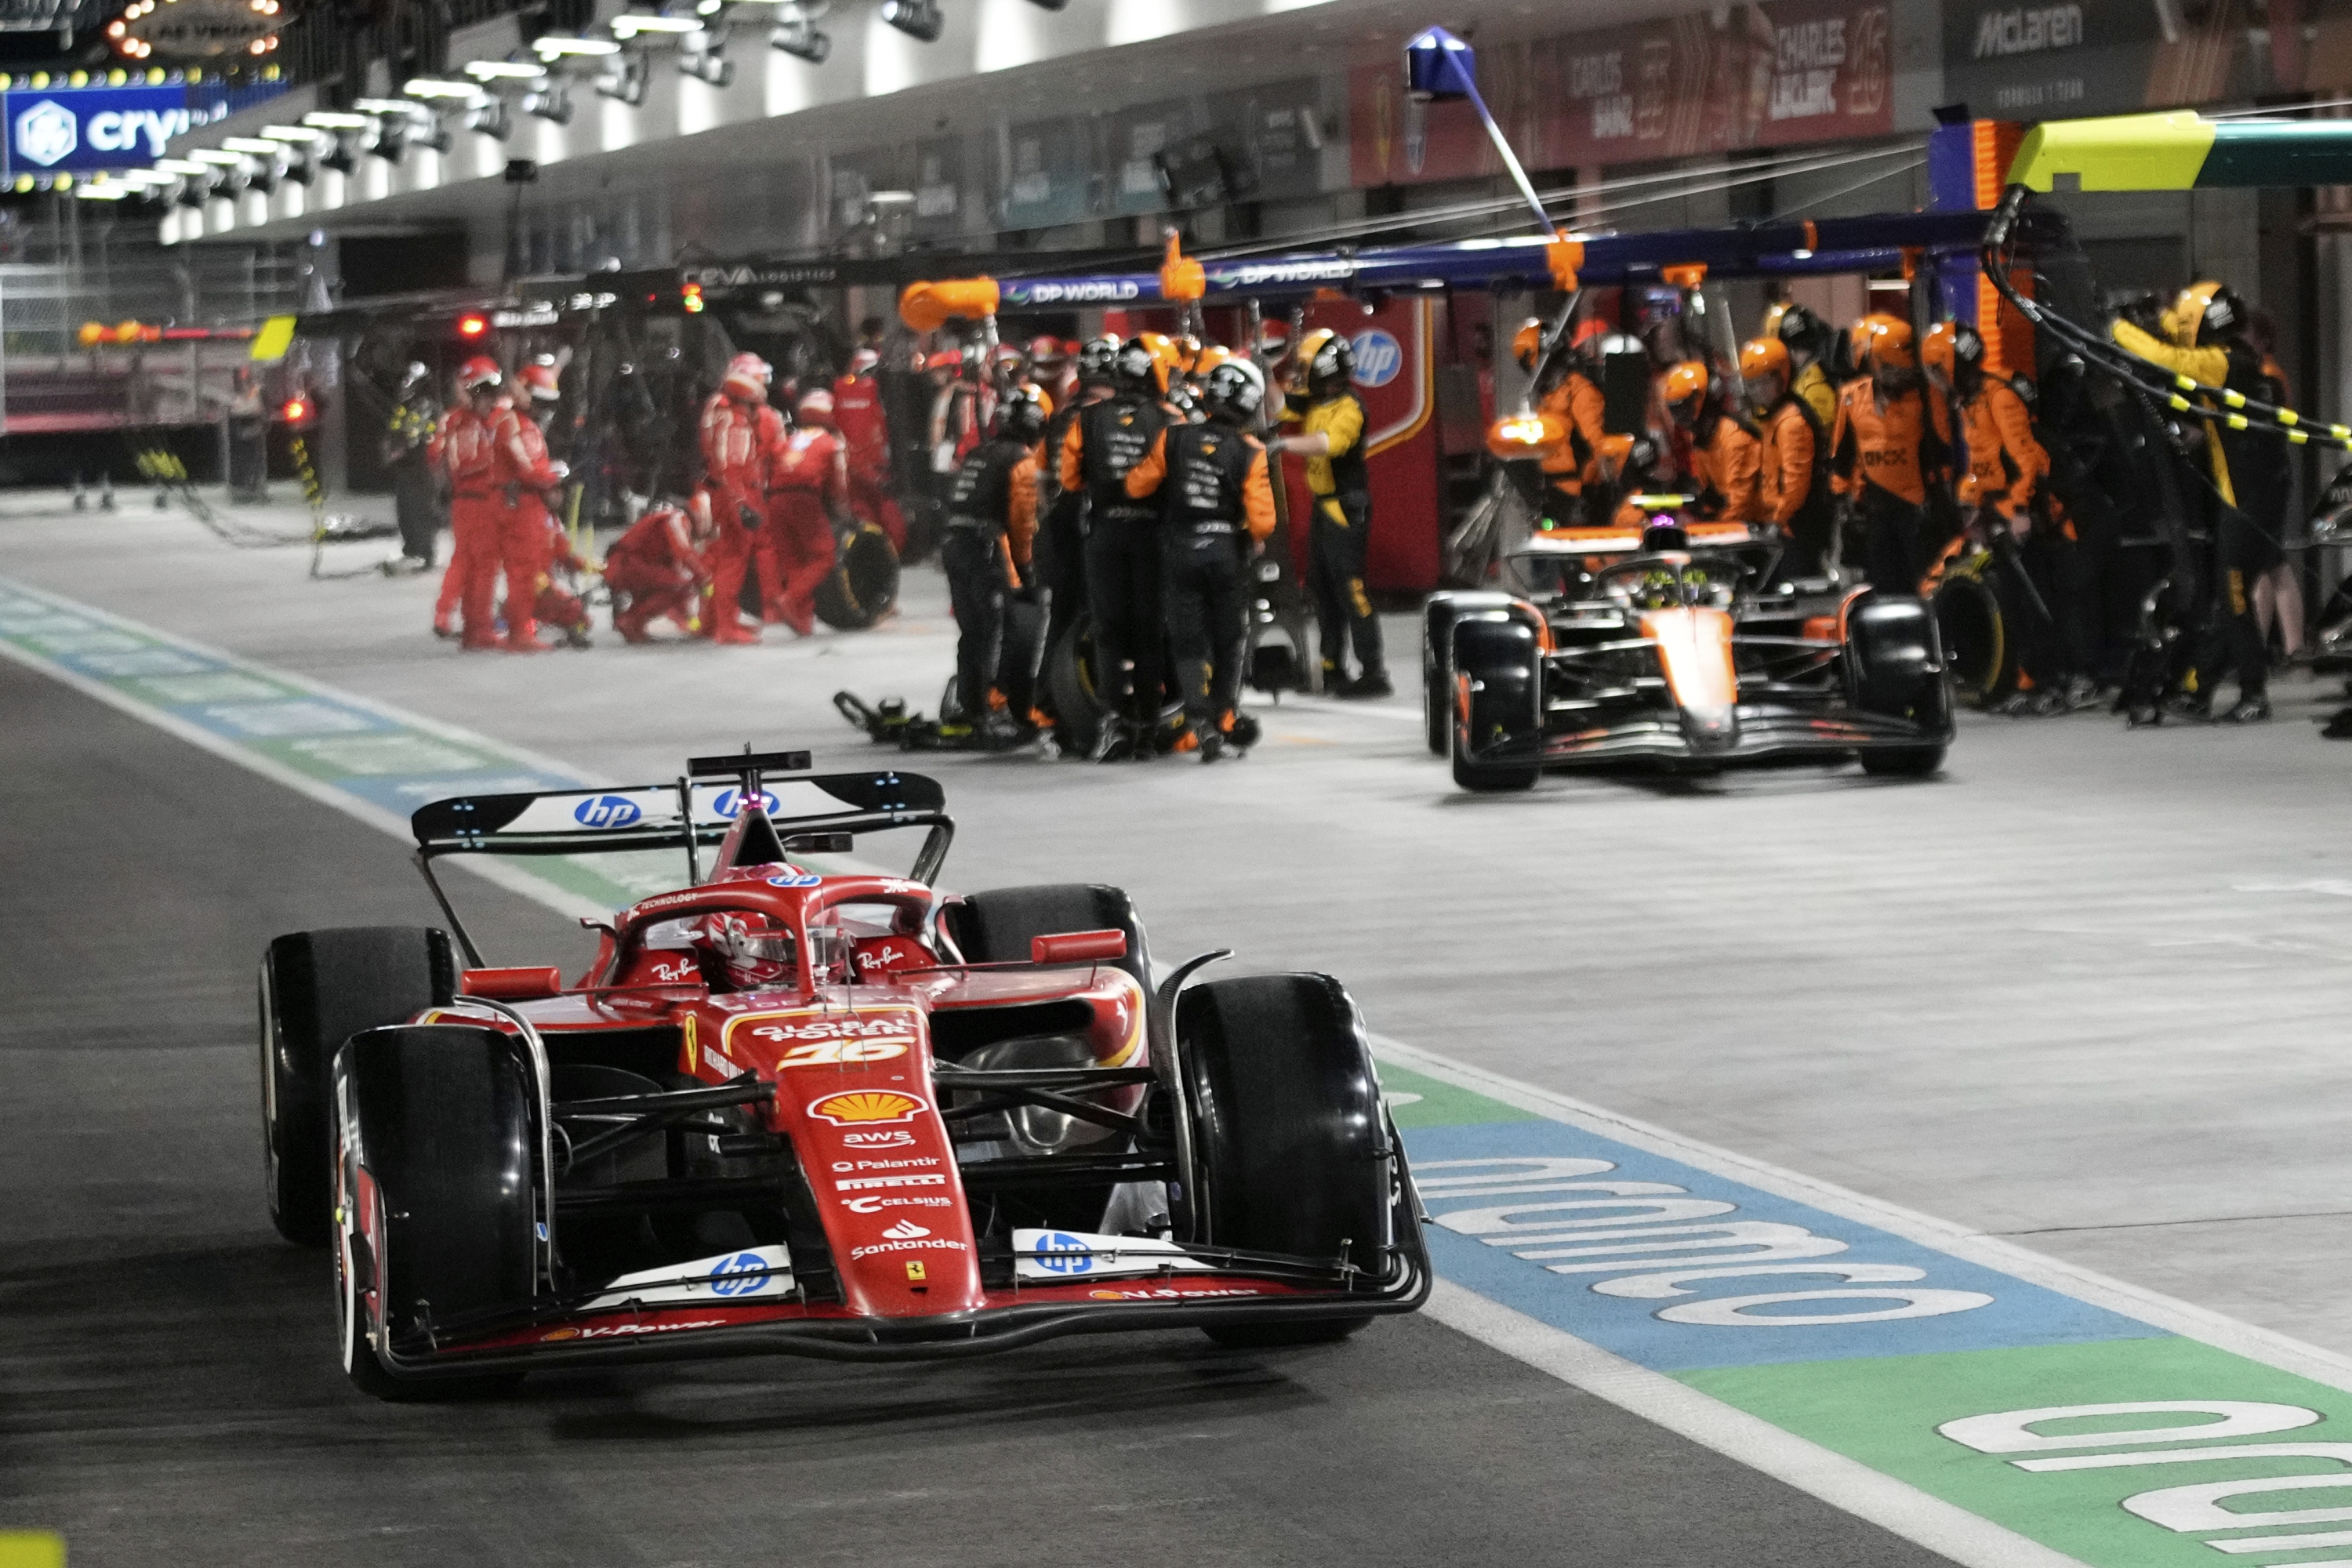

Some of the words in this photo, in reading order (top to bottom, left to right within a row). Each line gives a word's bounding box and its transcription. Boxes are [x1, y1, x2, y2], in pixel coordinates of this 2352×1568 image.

[1972, 5, 2082, 58] McLaren
[87, 109, 190, 157] cry
[1033, 285, 1063, 303] DP
[1063, 281, 1139, 301] WORLD
[1357, 332, 1396, 385] hp
[583, 794, 634, 829] hp
[641, 892, 699, 910] TECHNOLOGY
[856, 946, 905, 971] Ray-Ban
[752, 1019, 918, 1036] GLOBAL
[769, 1025, 909, 1042] POKER
[775, 1036, 917, 1073] 16
[844, 1131, 912, 1144] aws
[857, 1156, 941, 1170] Palantir
[836, 1174, 946, 1191] PIRELLI
[882, 1196, 953, 1207] CELSIUS
[851, 1239, 968, 1260] Santander
[1121, 1288, 1259, 1299] V-Power
[583, 1319, 727, 1338] V-Power
